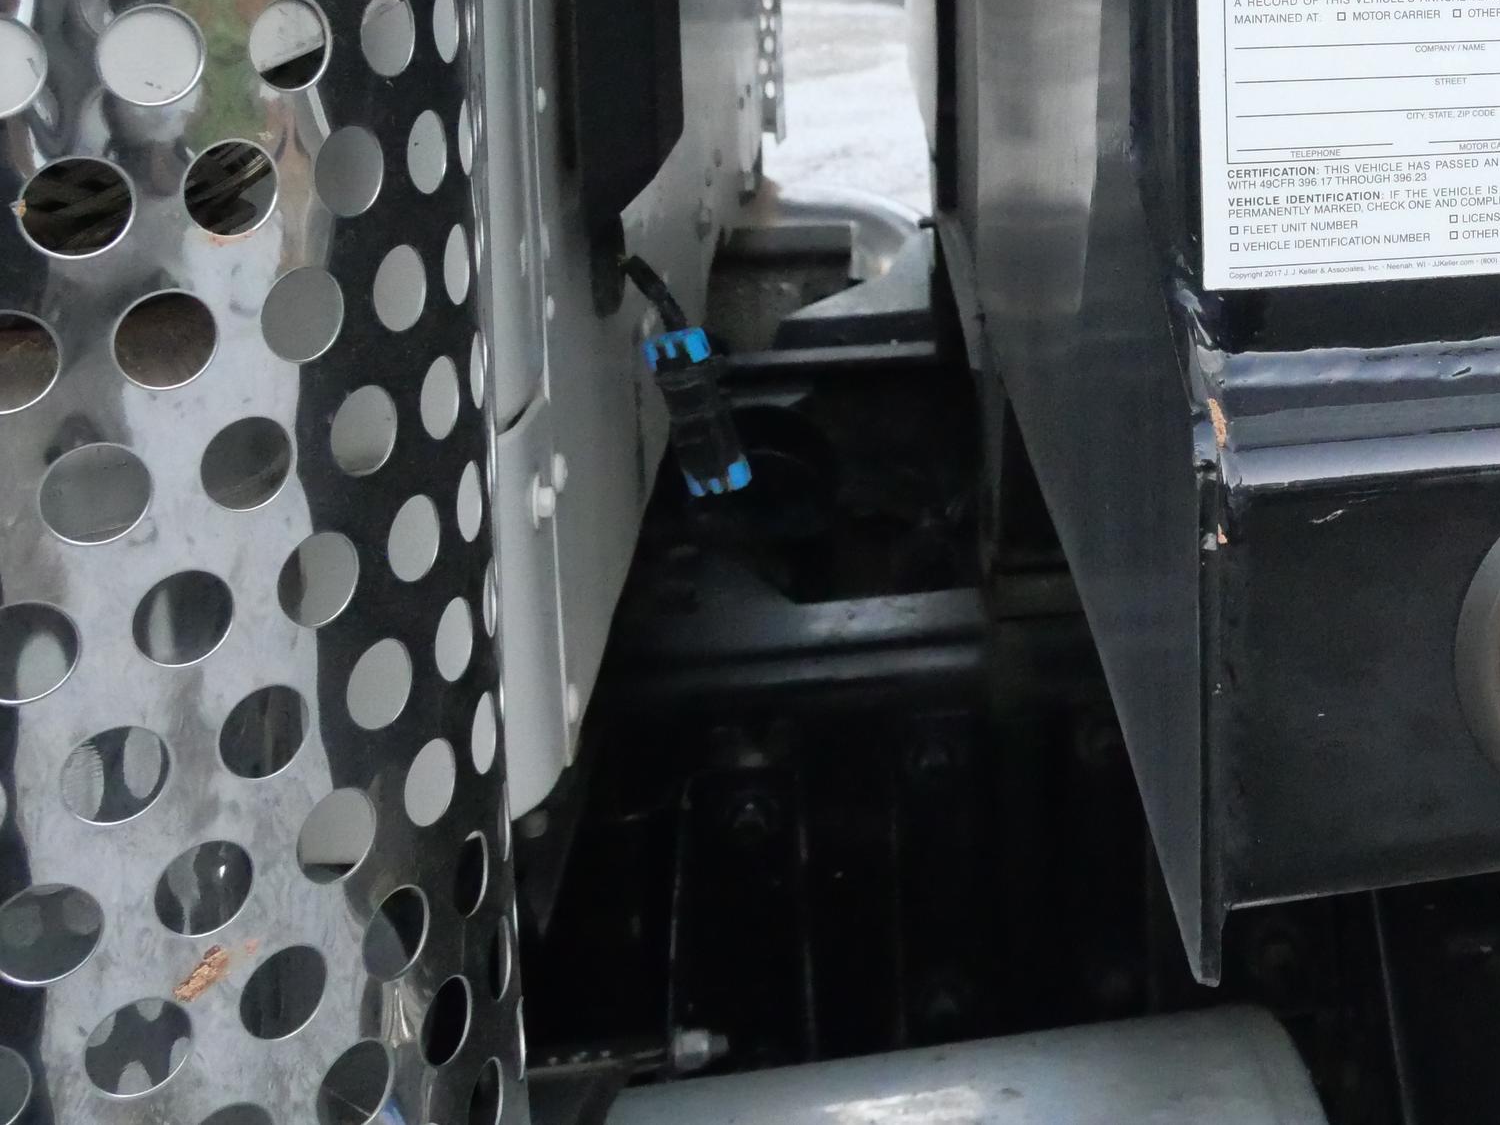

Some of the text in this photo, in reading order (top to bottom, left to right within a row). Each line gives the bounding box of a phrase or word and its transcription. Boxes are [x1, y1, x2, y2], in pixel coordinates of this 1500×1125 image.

[1234, 13, 1303, 24] MAINTAINED
[1352, 9, 1441, 21] MOTOR CARRIER
[1415, 44, 1456, 53] COMPANY
[1462, 43, 1486, 51] NAME
[1434, 77, 1468, 86] STREET
[1457, 110, 1471, 118] ZIP
[1472, 109, 1496, 117] CODE
[1459, 142, 1489, 151] MOTOR
[1290, 149, 1341, 158] TELEPHONE
[1227, 166, 1319, 179] CERTIFICATION:
[1323, 164, 1350, 175] THIS
[1354, 162, 1403, 173] VEHICLE
[1408, 160, 1430, 171] HAS
[1435, 158, 1479, 169] PASSED
[1484, 158, 1499, 167] AN
[1227, 180, 1256, 190] WITH
[1259, 178, 1295, 189] 49CFR
[1334, 174, 1391, 185] THROUGH
[1228, 196, 1280, 207] VEHICLE
[1286, 191, 1384, 204] IDENTIFICATION:
[1390, 190, 1400, 199] IF
[1404, 188, 1427, 198] THE
[1433, 186, 1482, 197] VEHICLE
[1488, 185, 1498, 195] IS
[1228, 205, 1311, 218] PERMANENTLY
[1366, 200, 1407, 212] CHECK
[1408, 199, 1432, 210] ONE
[1433, 198, 1457, 208] AND
[1243, 220, 1358, 235] FLEET UNIT NUMBER
[1462, 228, 1499, 240] OTHER
[1242, 232, 1430, 251] VEHICLE IDENTIFICATION NUMBER
[1229, 270, 1263, 279] Copyright
[1264, 269, 1282, 277] 2017
